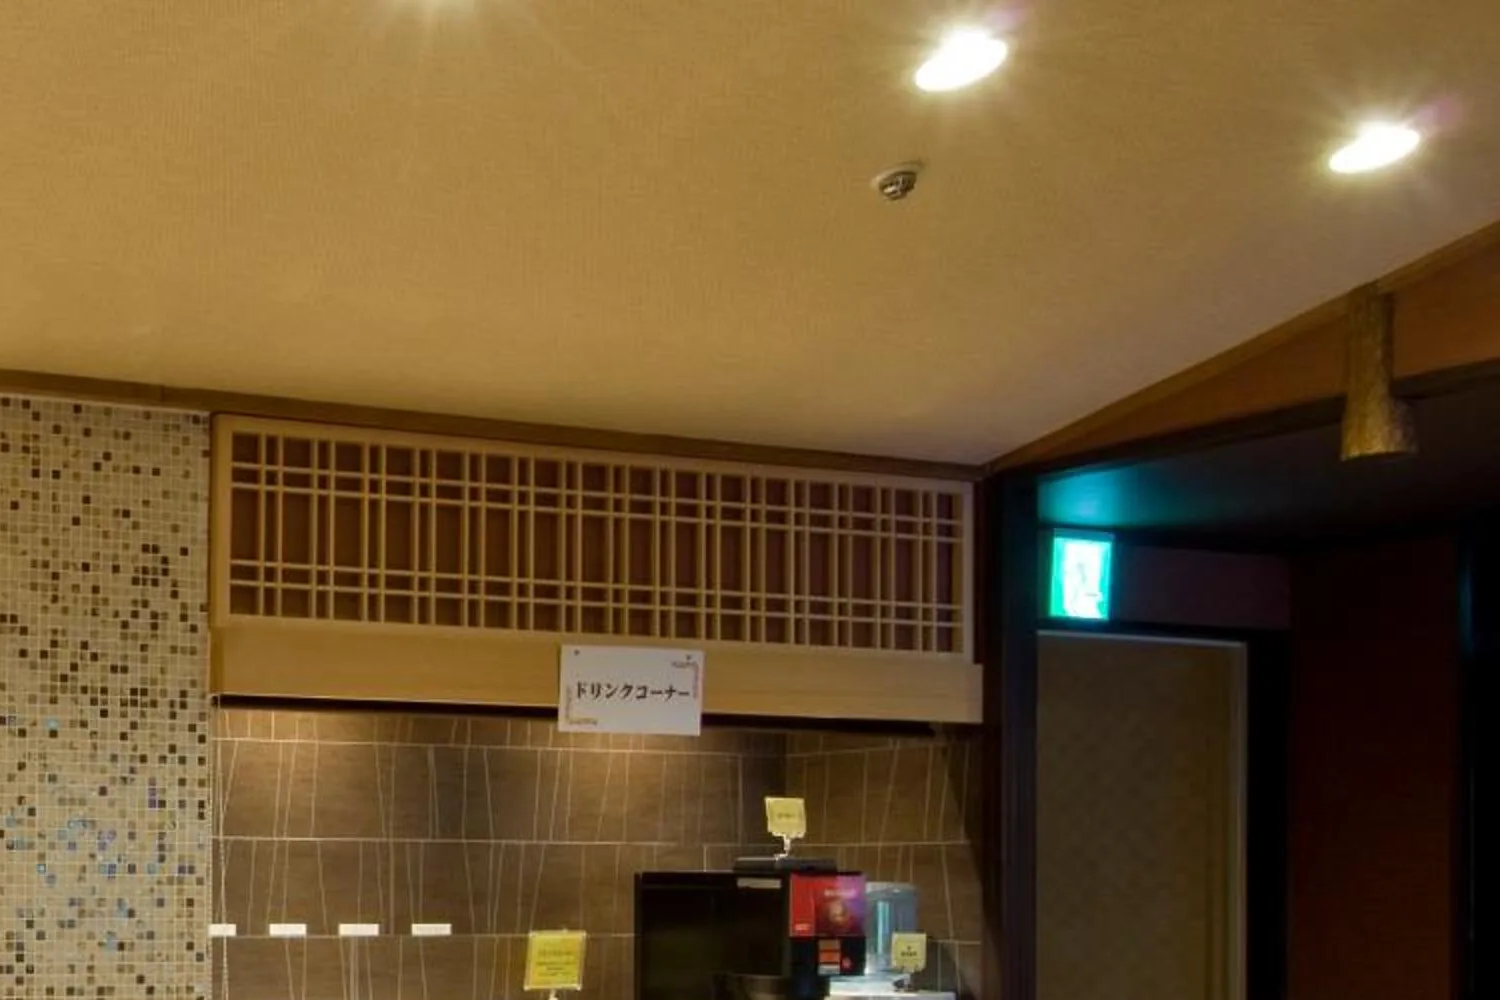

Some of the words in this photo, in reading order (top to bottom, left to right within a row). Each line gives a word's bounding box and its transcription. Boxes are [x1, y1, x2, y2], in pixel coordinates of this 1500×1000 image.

[577, 680, 690, 700] ドリンクコーナー
